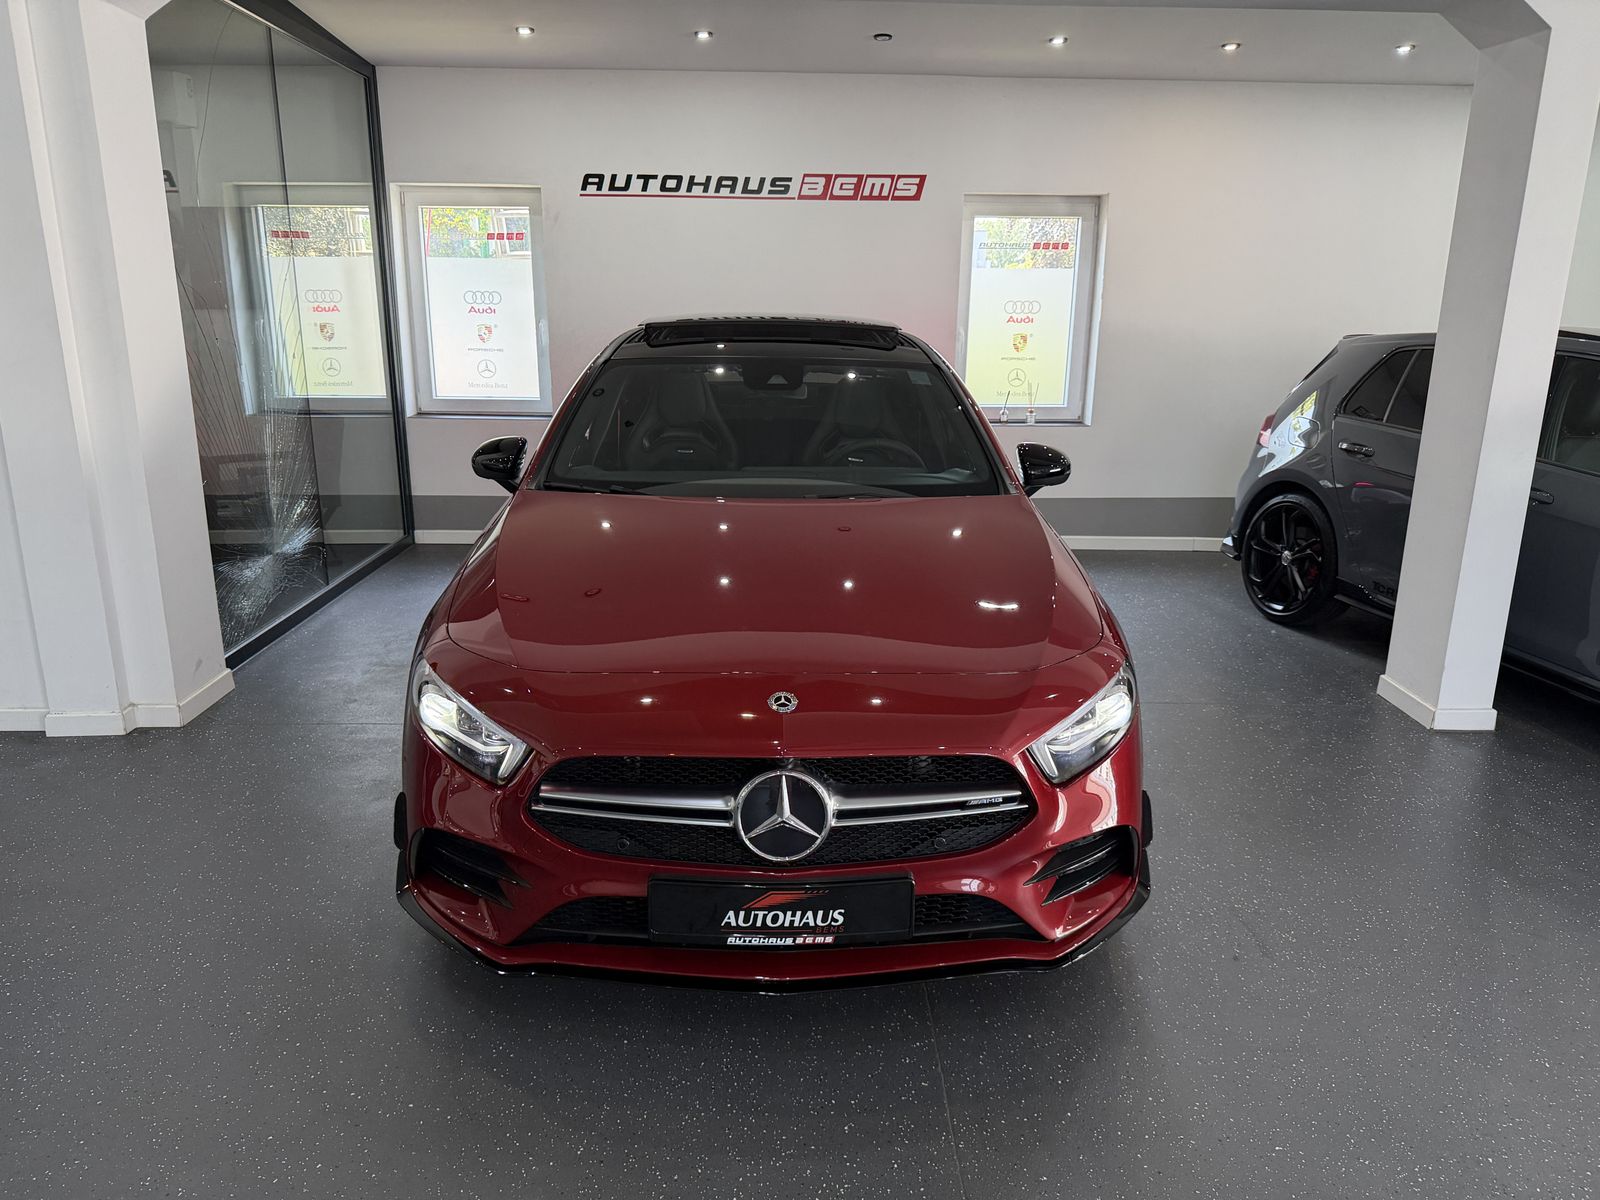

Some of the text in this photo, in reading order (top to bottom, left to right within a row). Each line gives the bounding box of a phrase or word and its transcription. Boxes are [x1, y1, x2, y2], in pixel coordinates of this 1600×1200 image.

[580, 173, 926, 201] AUTOHAUS BEMS
[978, 242, 1030, 250] AUTOHAUS
[467, 306, 497, 315] Audi
[1006, 315, 1034, 324] Audi
[721, 909, 845, 928] AUTOHAUS
[727, 935, 834, 945] AUTOHAUS BEMS
